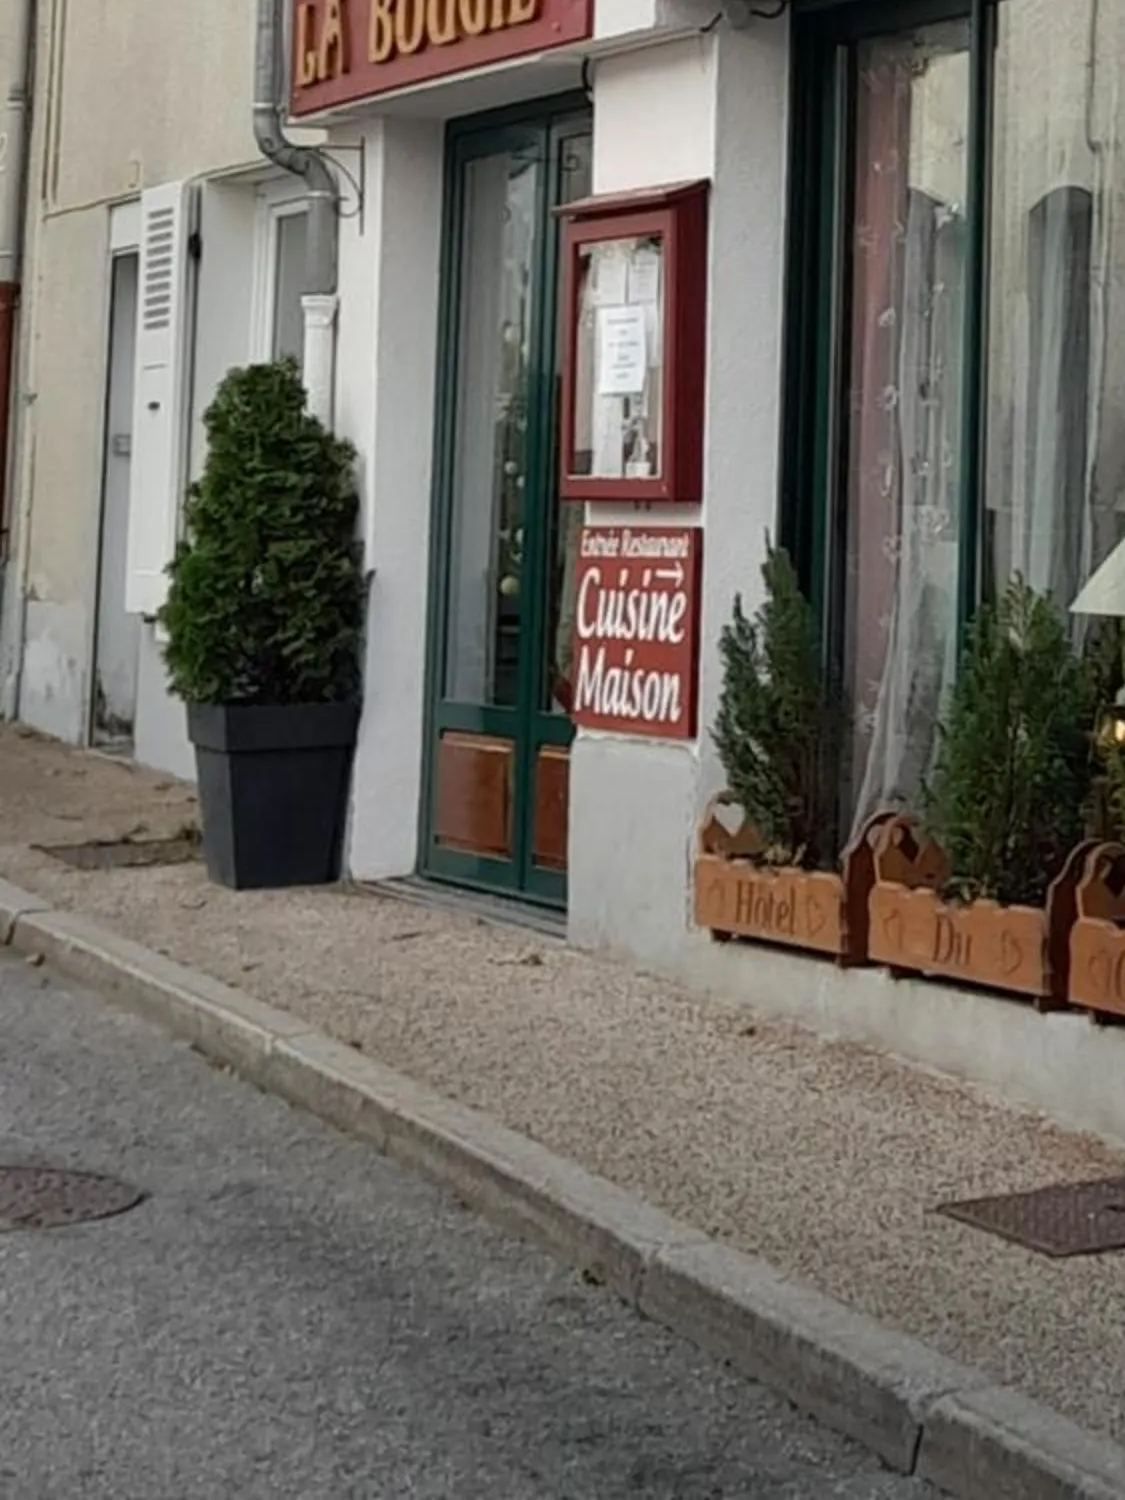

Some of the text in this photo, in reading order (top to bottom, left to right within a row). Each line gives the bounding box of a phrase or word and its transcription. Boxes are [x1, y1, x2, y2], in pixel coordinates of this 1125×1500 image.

[577, 567, 687, 644] Cuisine
[575, 644, 681, 723] Maison
[931, 914, 972, 966] Du
